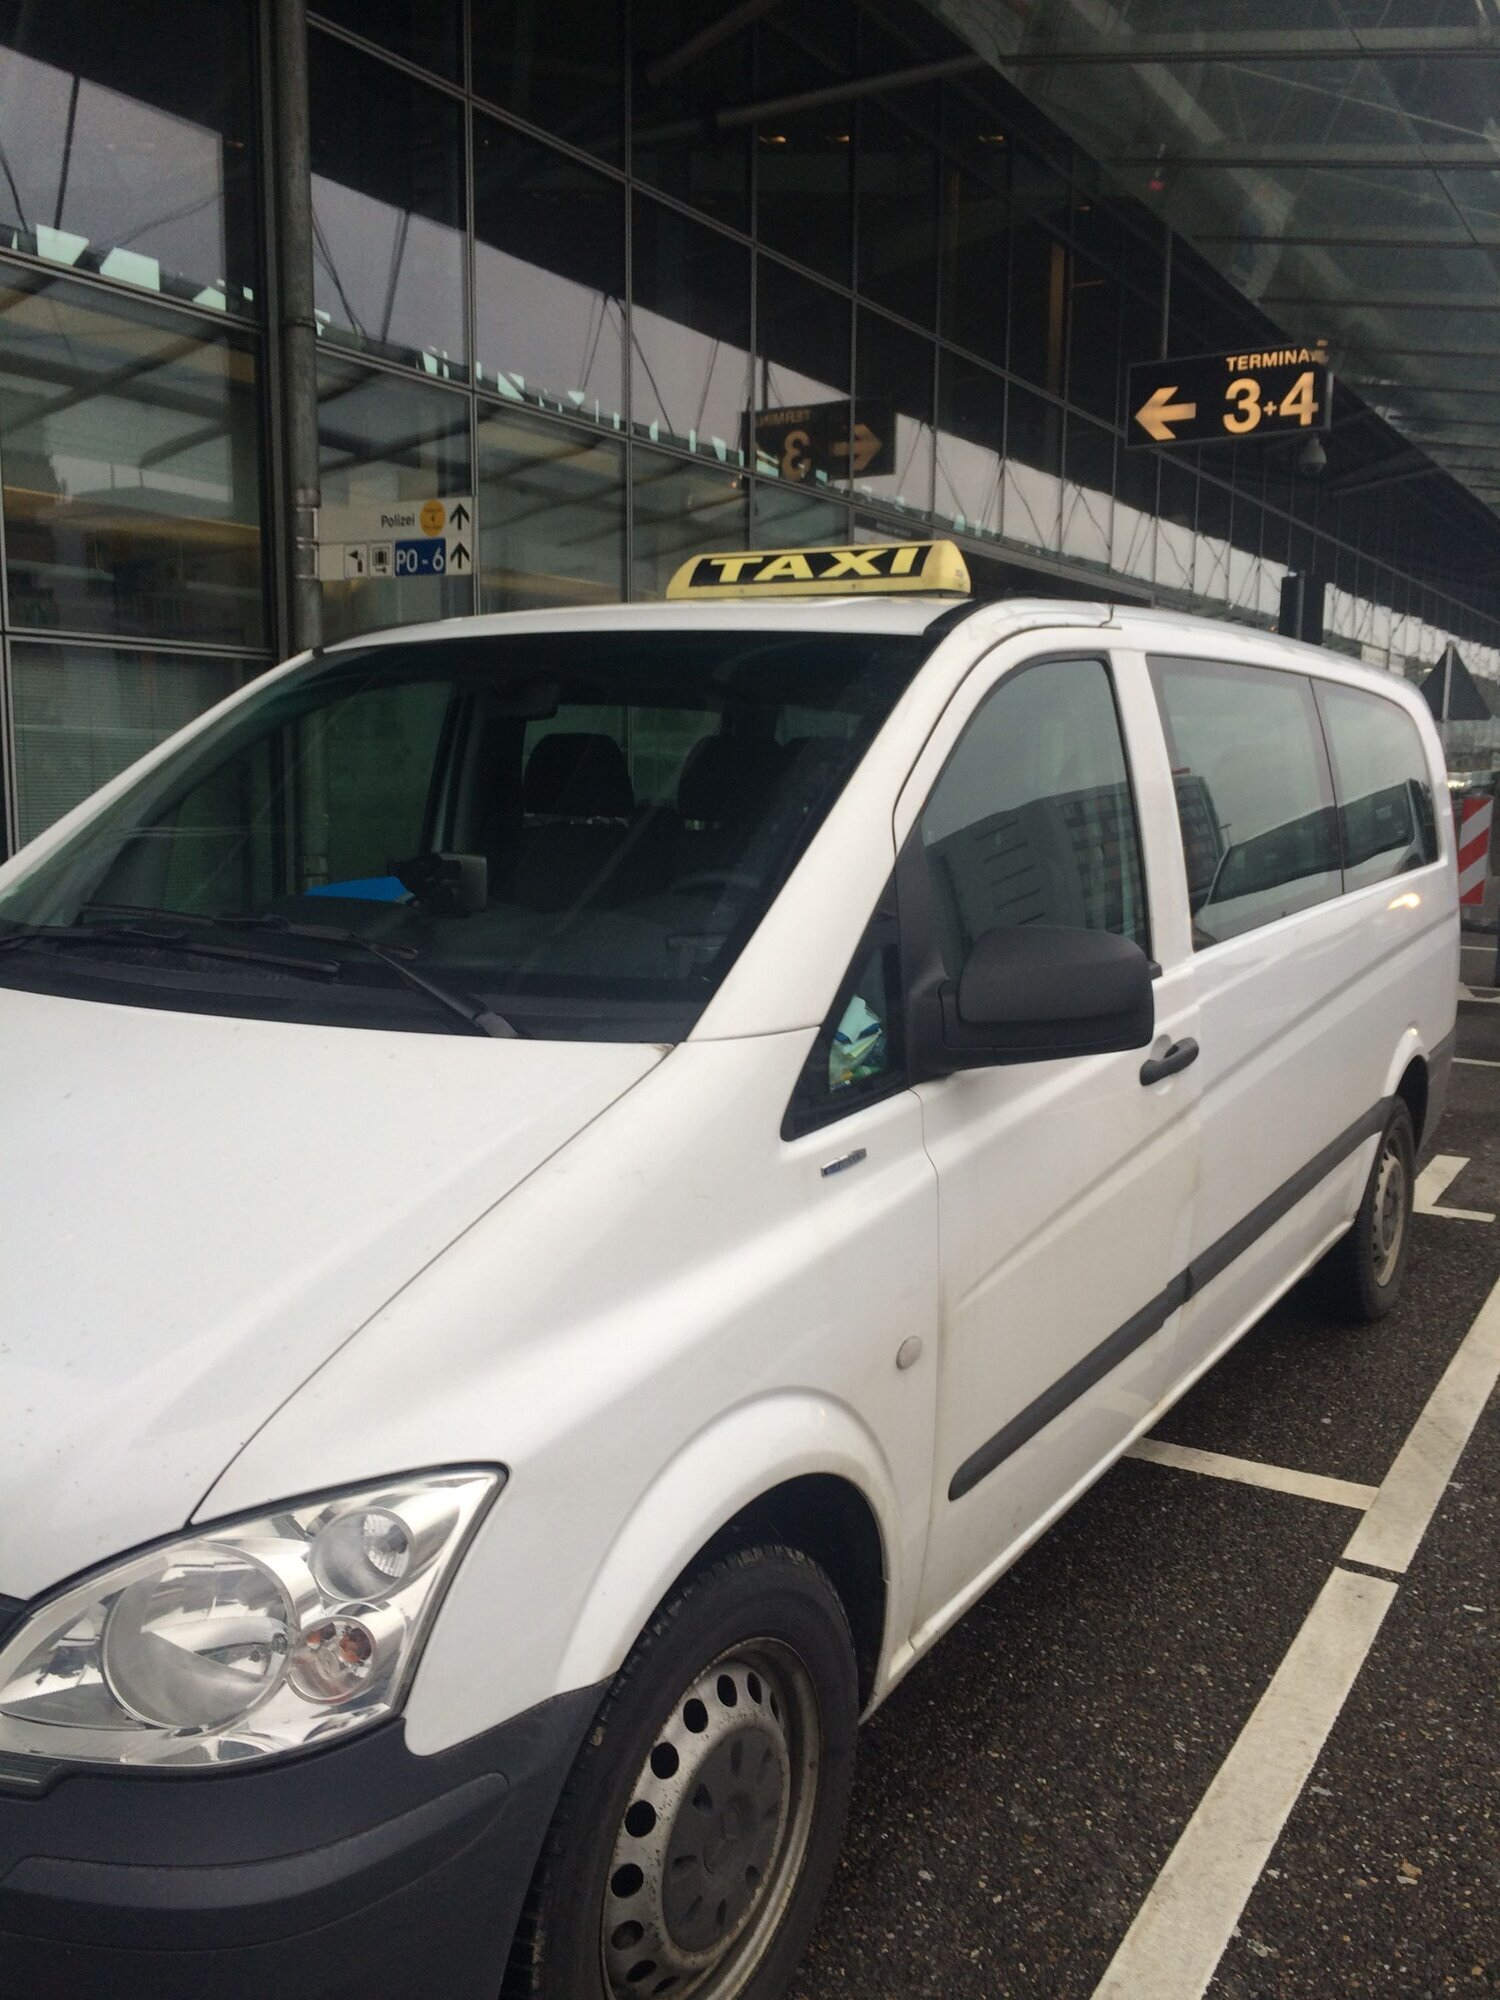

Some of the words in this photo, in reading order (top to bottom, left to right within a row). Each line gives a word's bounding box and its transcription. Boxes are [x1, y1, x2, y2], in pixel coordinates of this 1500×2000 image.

[1226, 348, 1322, 372] TERMINA
[381, 513, 415, 527] Polizei
[710, 547, 919, 583] TAXI
